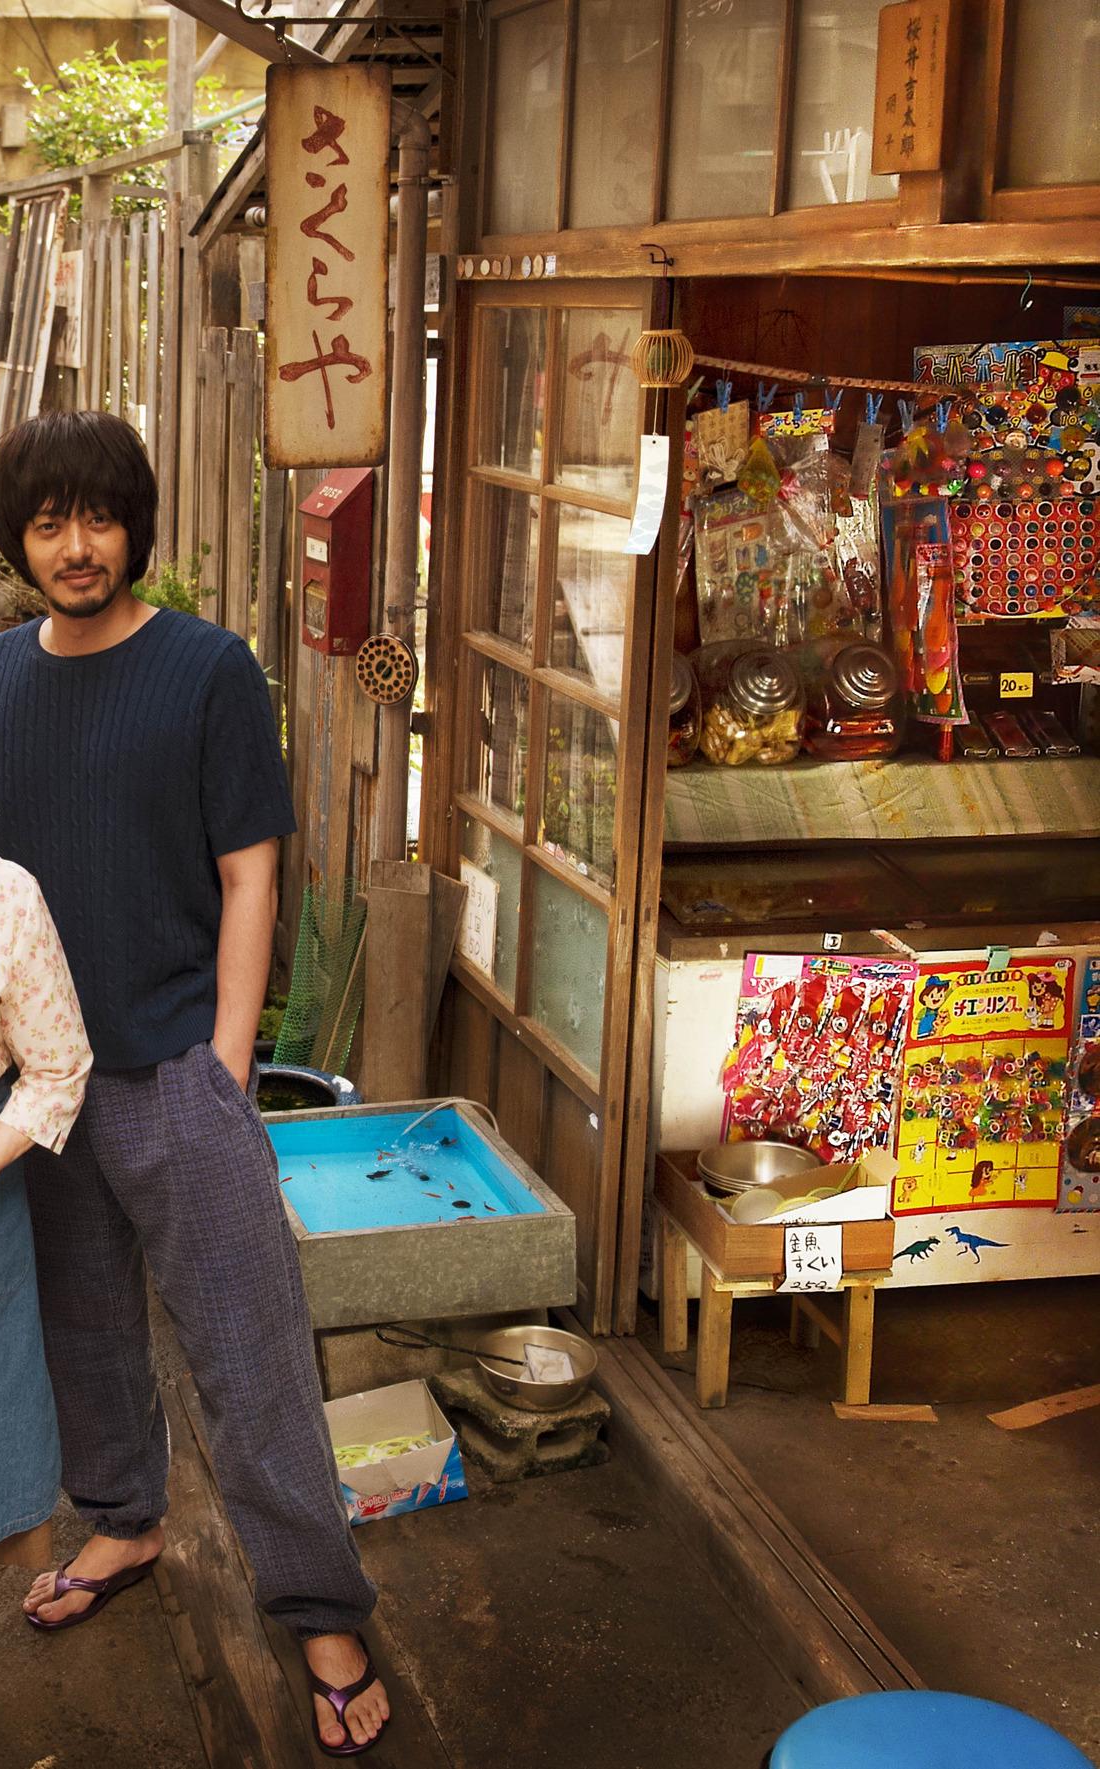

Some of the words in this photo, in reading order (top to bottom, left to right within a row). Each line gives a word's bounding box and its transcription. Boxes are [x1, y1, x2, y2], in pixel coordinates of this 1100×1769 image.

[279, 105, 373, 430] さくらや
[319, 485, 343, 499] POST
[789, 1232, 821, 1253] 金魚
[791, 1255, 836, 1273] すくい
